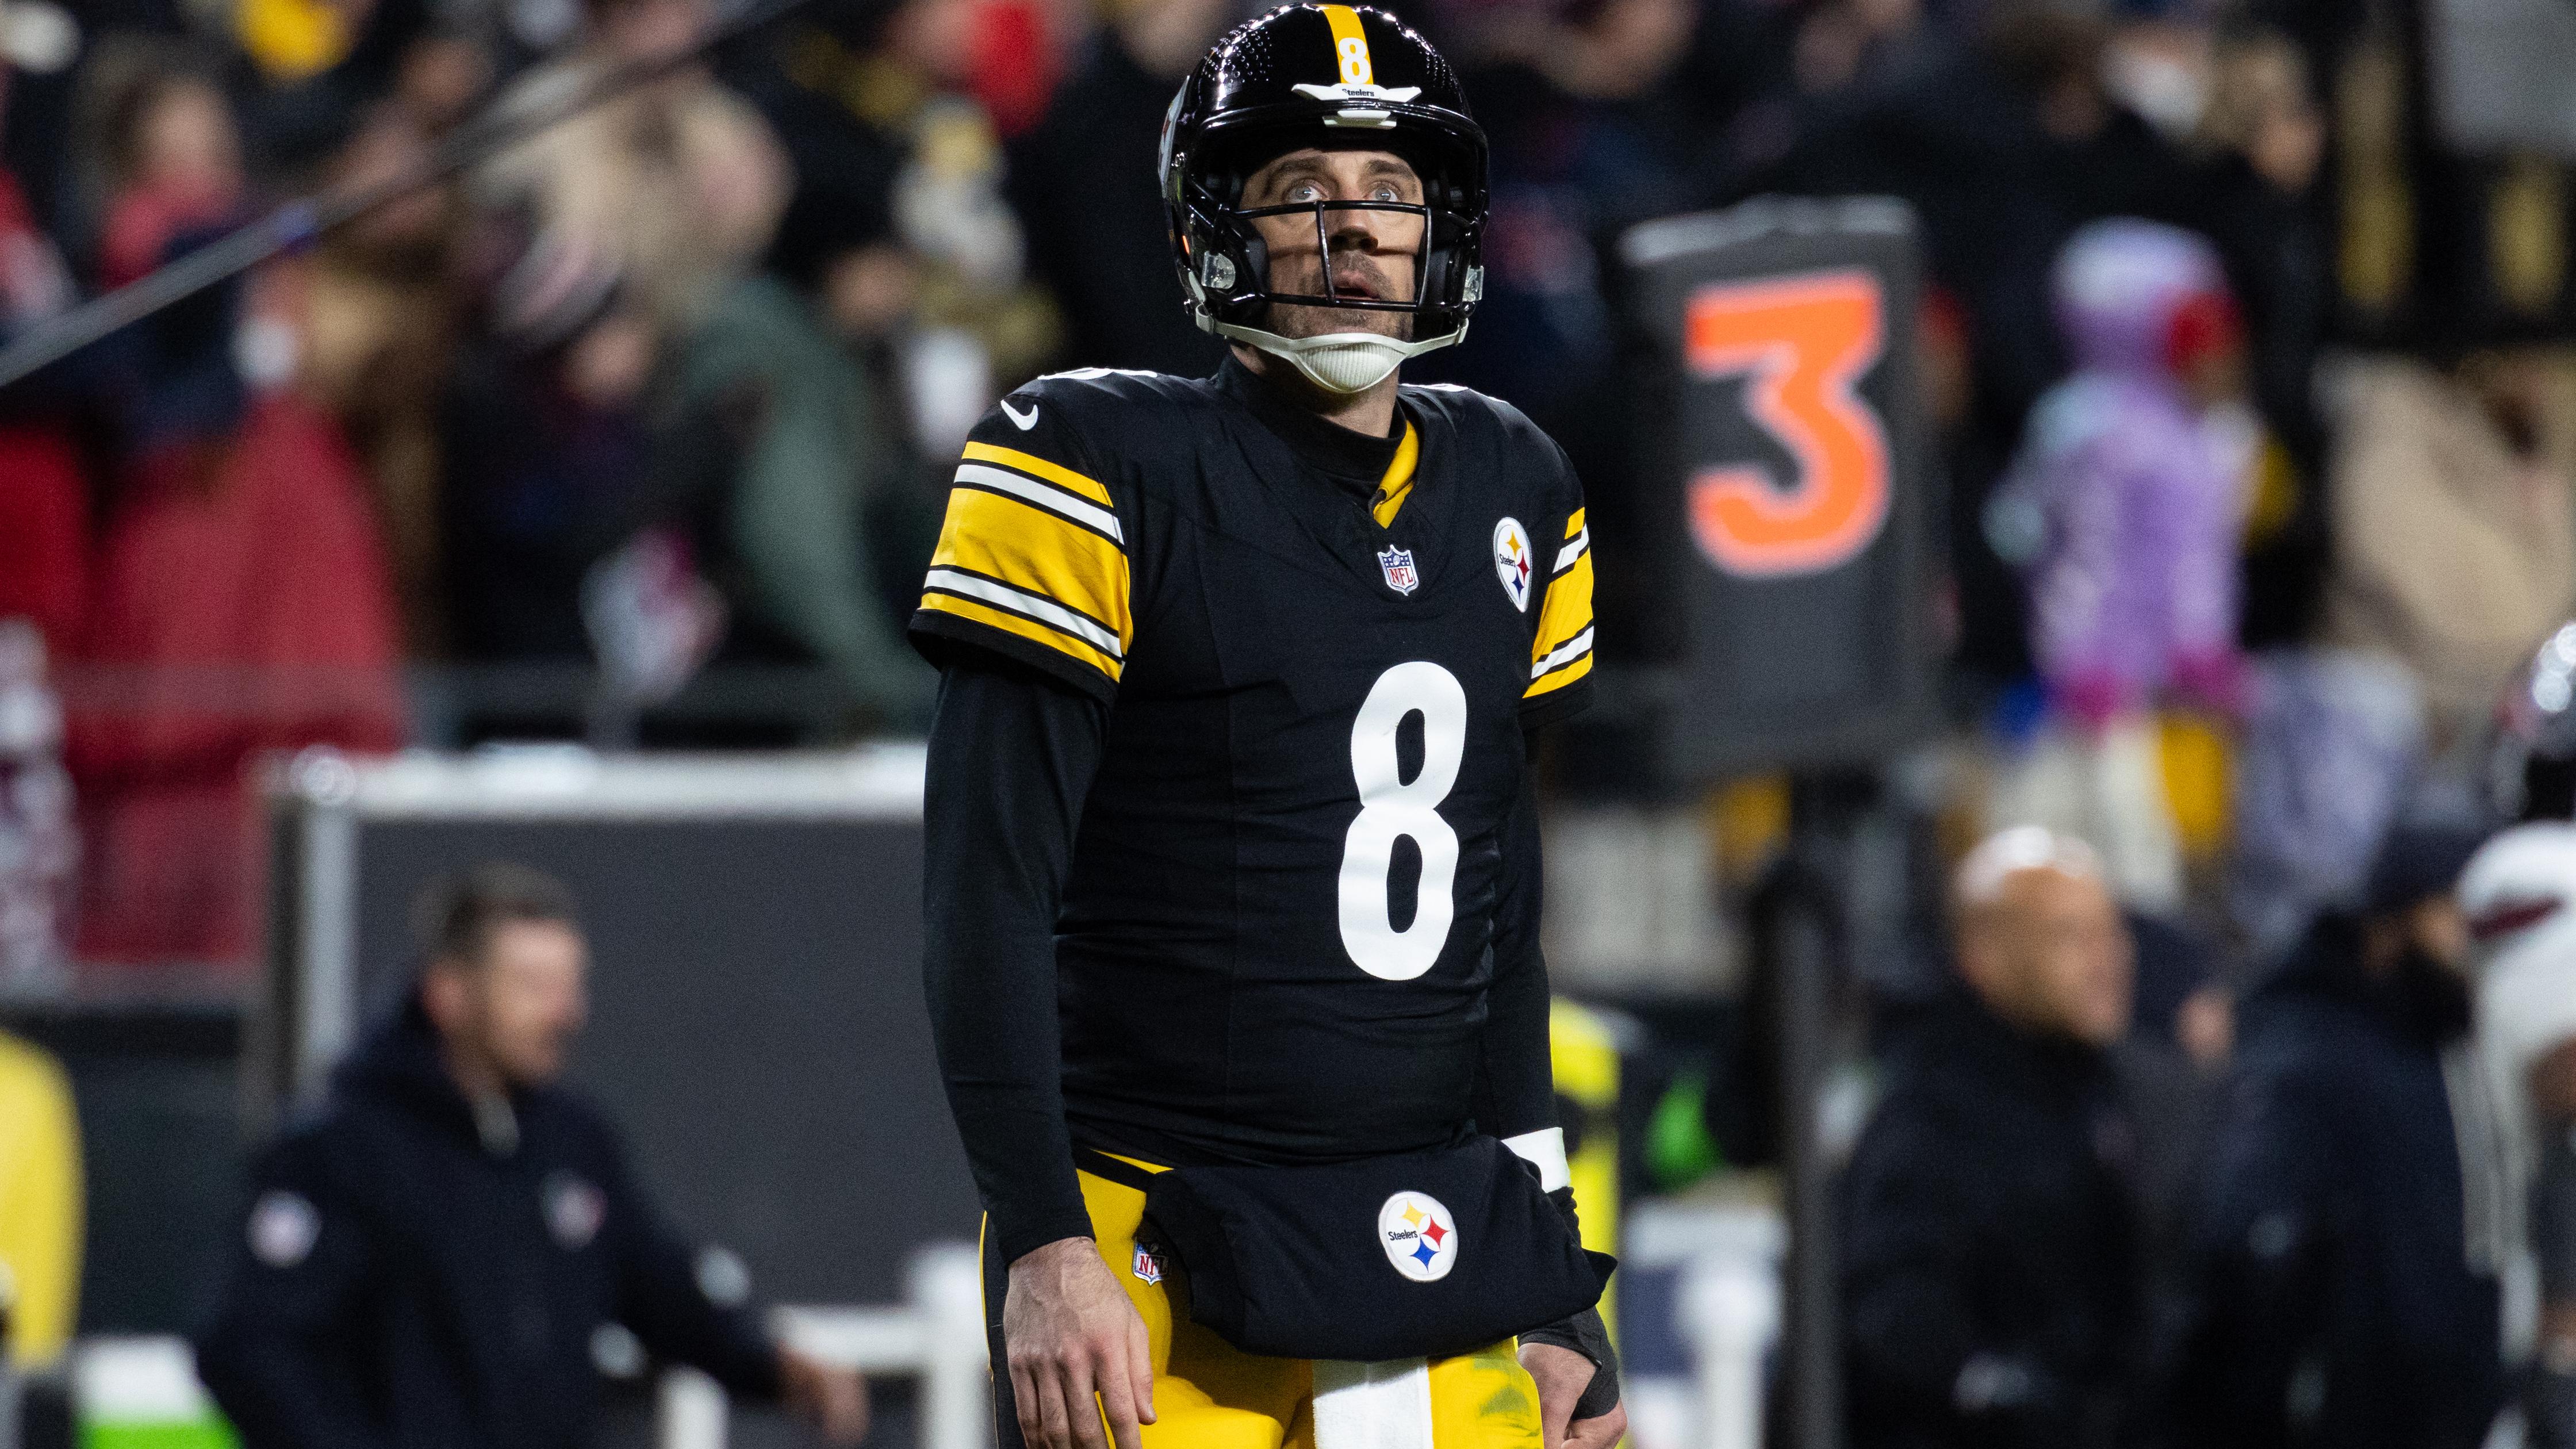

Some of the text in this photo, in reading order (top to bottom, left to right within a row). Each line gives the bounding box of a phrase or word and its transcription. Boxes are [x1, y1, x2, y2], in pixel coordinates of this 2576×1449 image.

[1338, 37, 1371, 84] 8
[1686, 273, 1886, 575] 3
[1389, 567, 1414, 586] NFL
[1339, 661, 1467, 980] 8
[1388, 1229, 1418, 1241] Steelers
